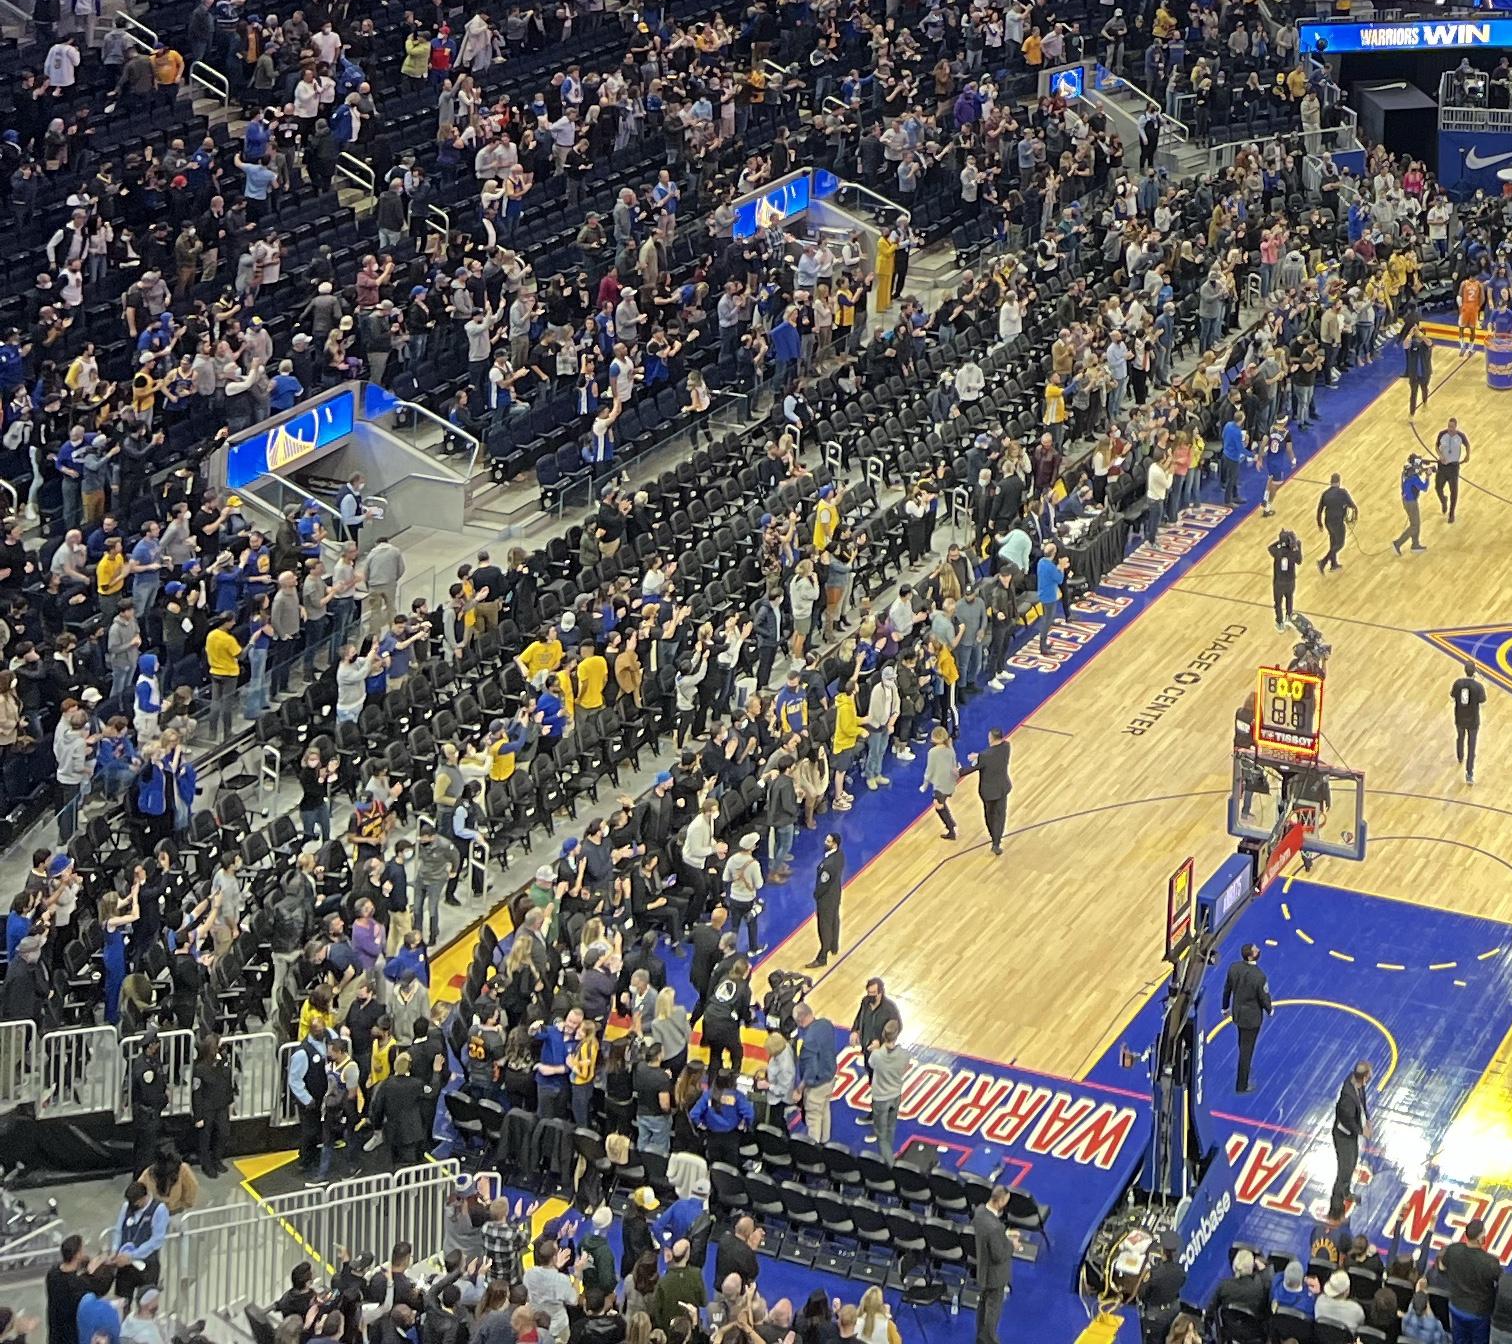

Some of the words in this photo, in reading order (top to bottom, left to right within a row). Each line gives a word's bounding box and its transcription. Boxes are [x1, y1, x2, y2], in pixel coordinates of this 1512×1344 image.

[1359, 26, 1419, 48] WARRIORS
[1422, 23, 1492, 45] WIN
[1006, 618, 1107, 674] YEARS
[1187, 623, 1248, 672] CHASE
[1121, 685, 1186, 738] CENTER
[1275, 730, 1314, 748] TISSOT
